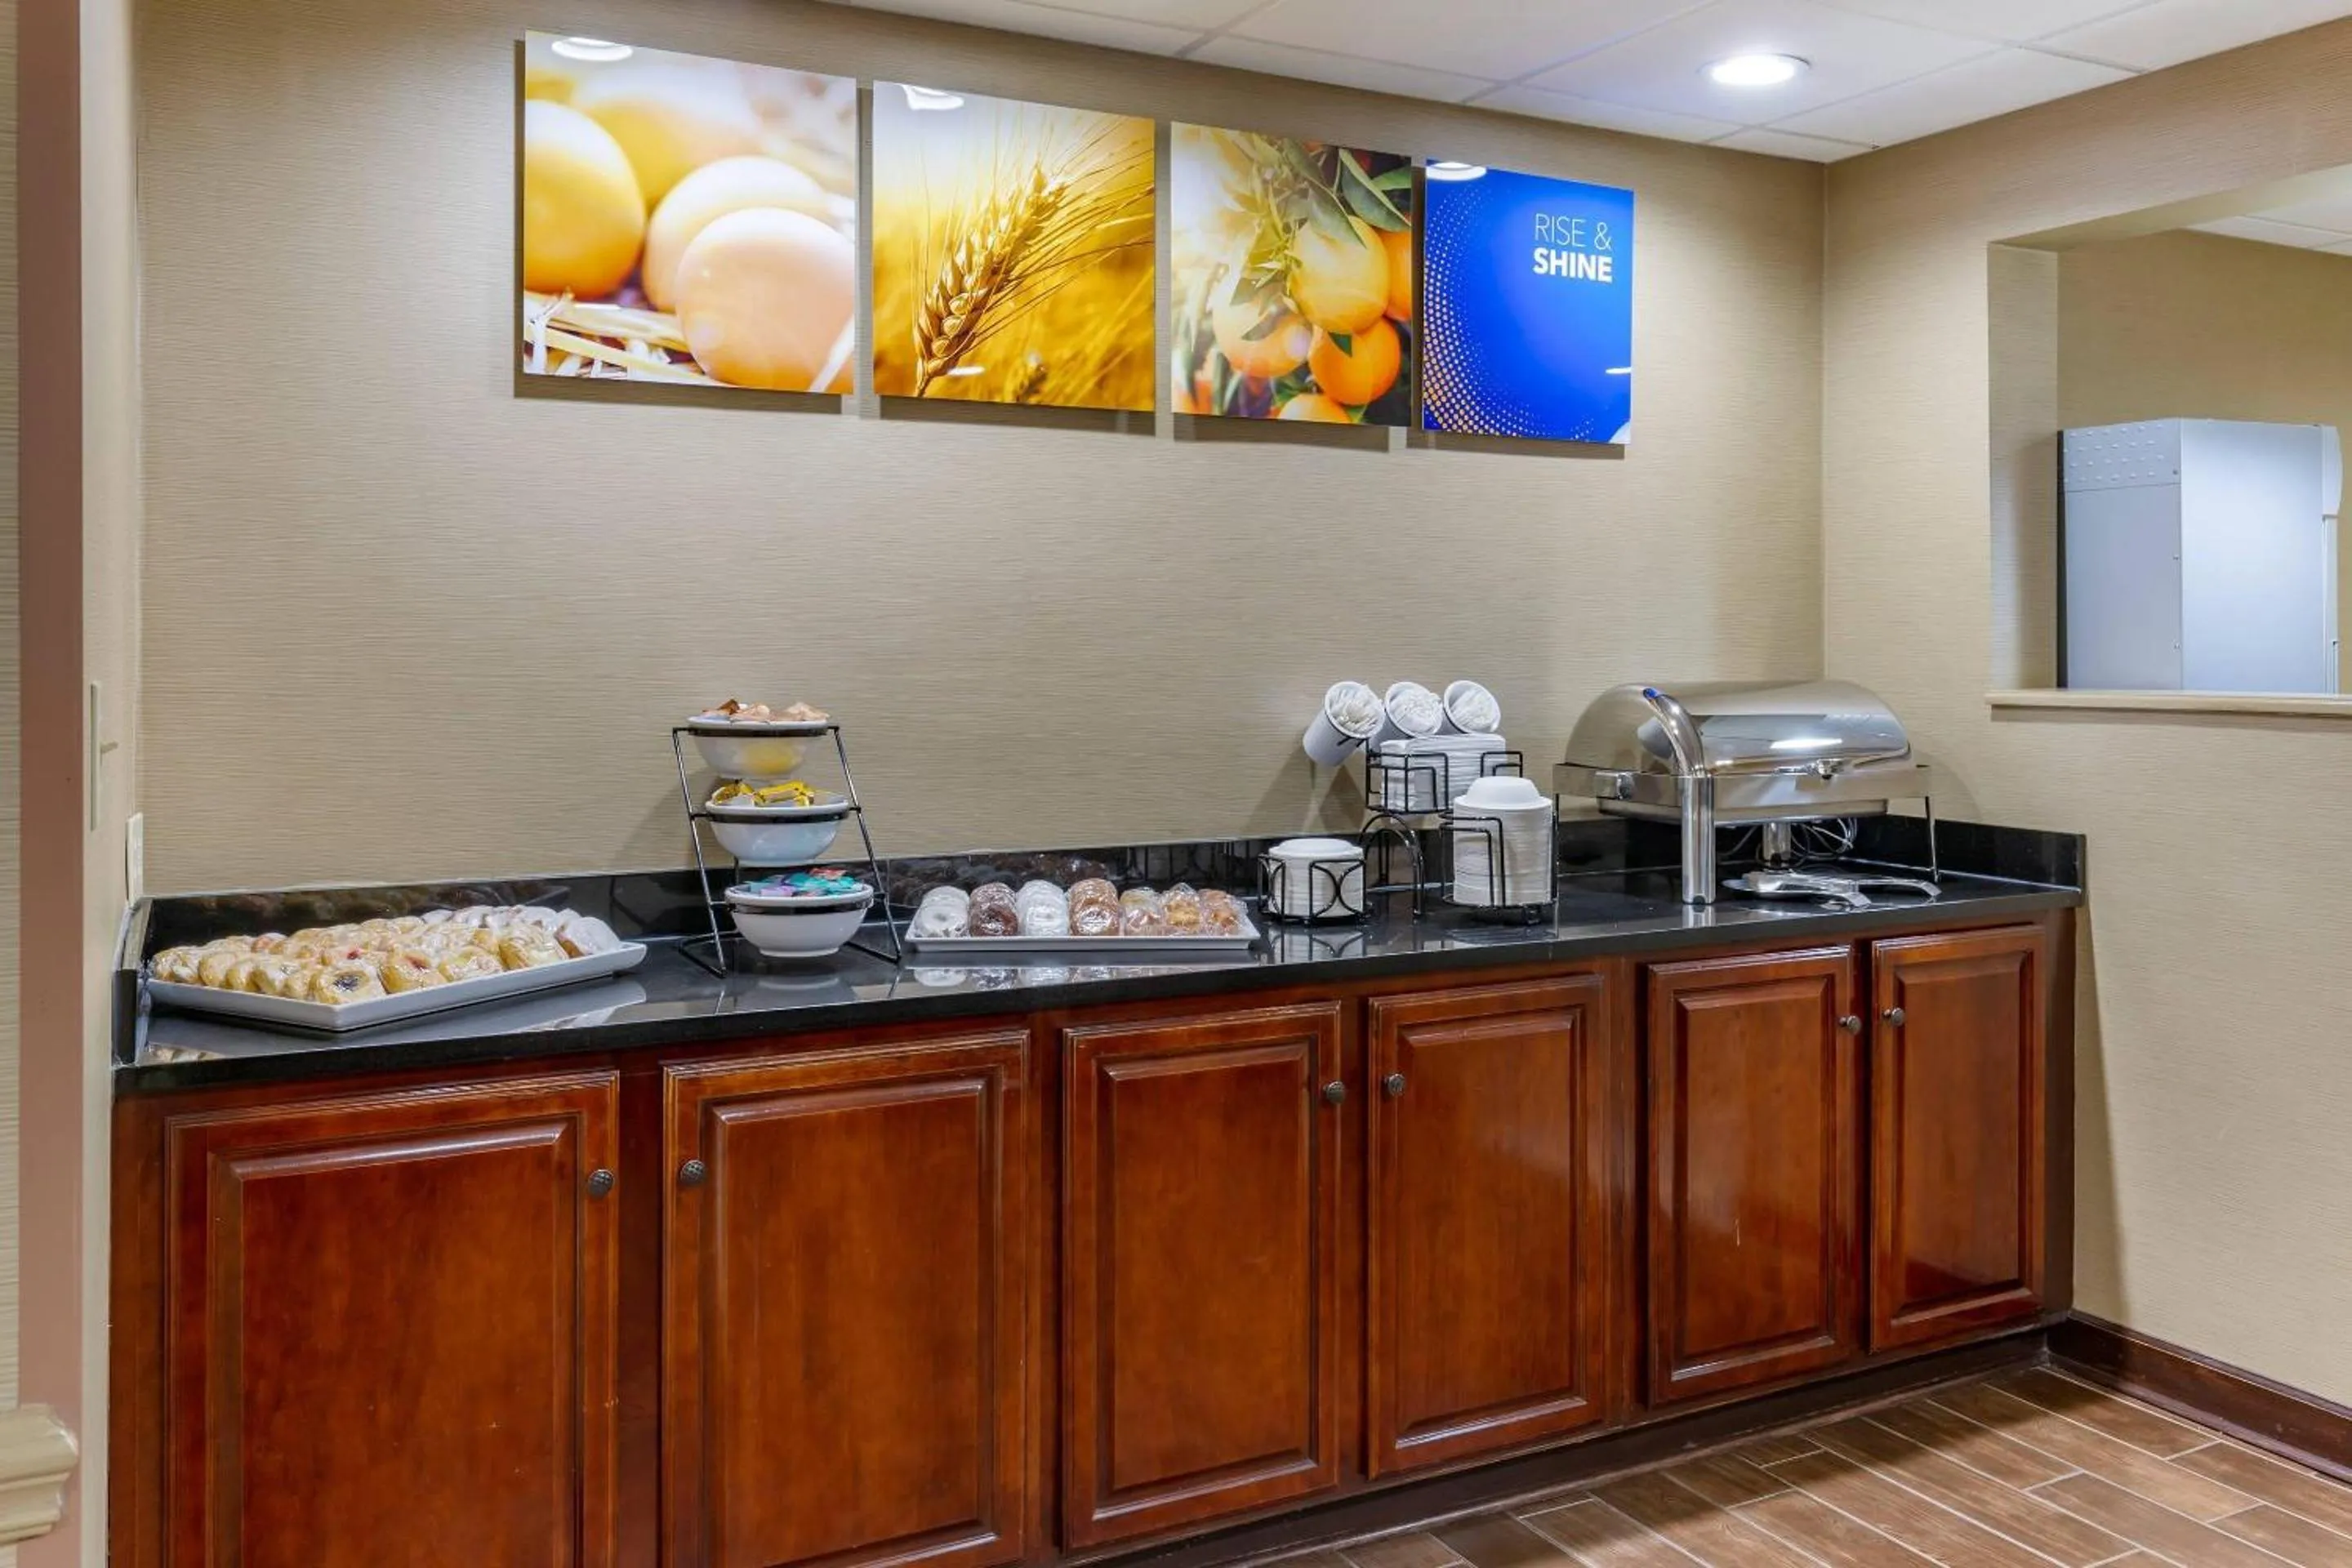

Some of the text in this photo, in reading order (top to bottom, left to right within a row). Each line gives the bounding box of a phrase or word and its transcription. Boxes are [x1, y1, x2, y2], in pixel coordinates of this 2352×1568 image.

[1535, 213, 1612, 252] RISE &
[1533, 247, 1613, 283] SHINE
